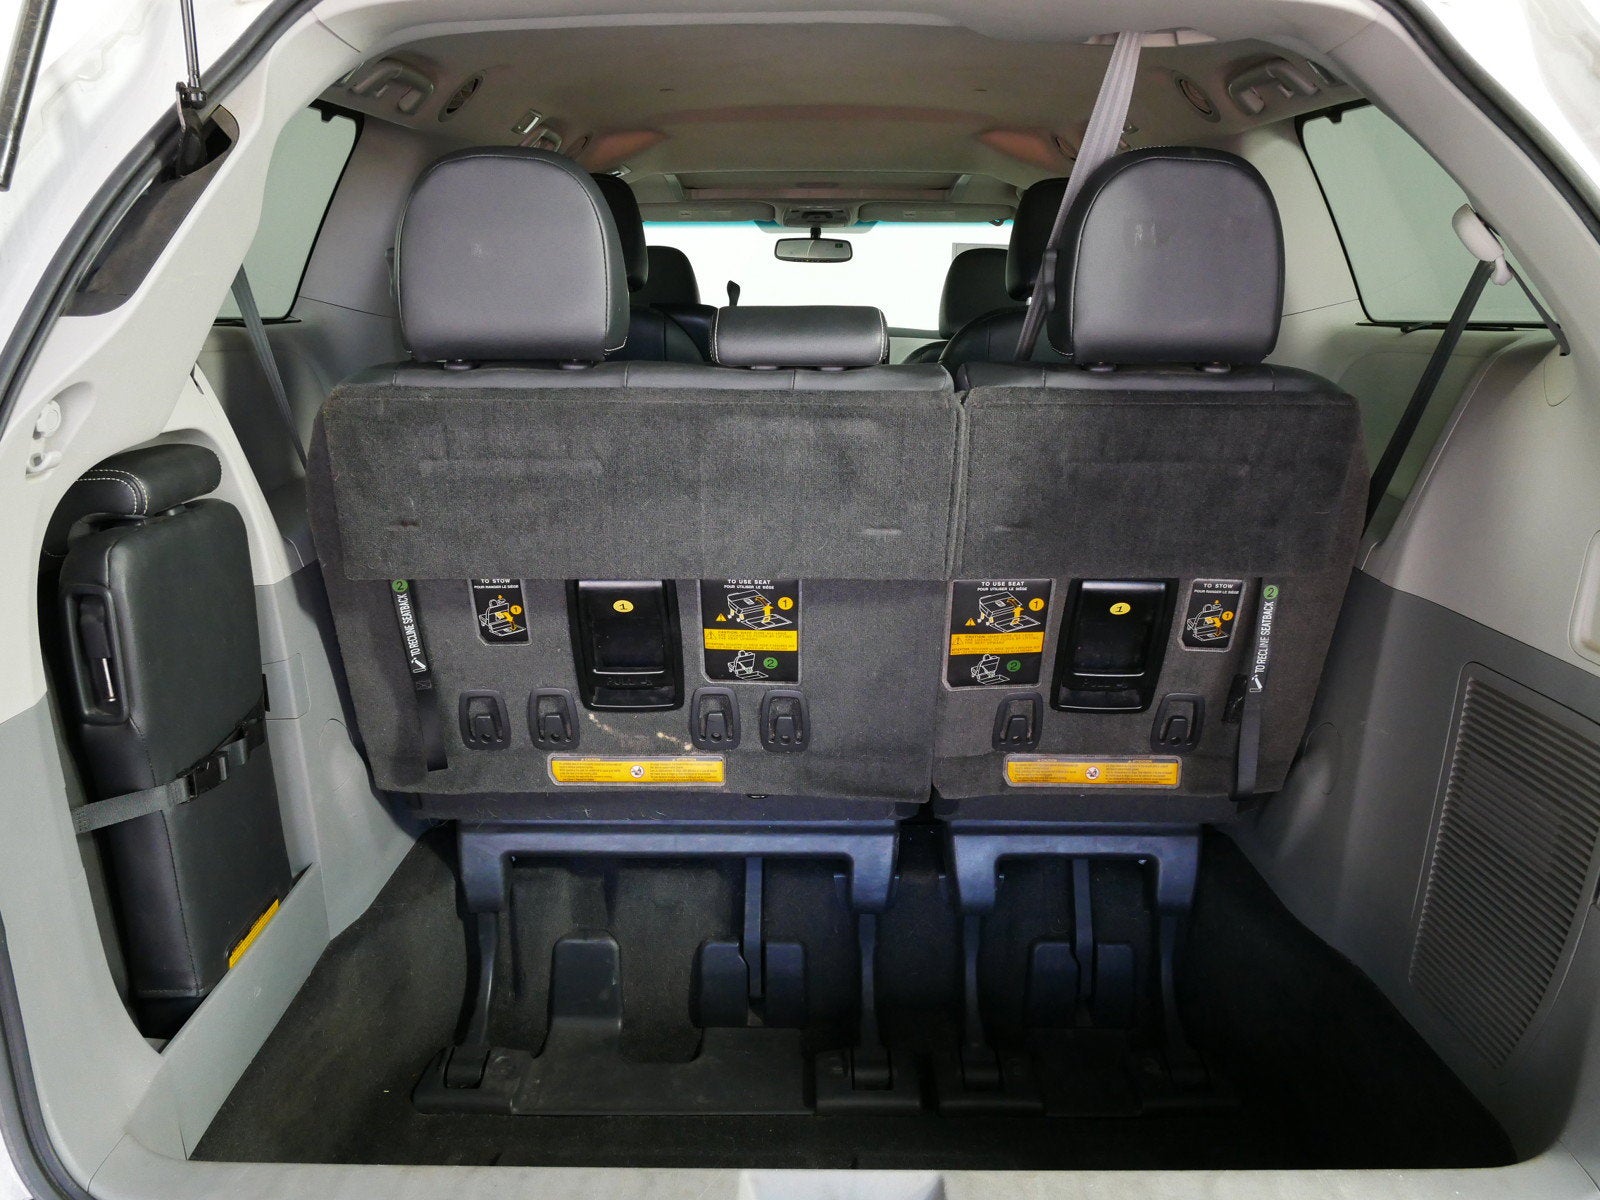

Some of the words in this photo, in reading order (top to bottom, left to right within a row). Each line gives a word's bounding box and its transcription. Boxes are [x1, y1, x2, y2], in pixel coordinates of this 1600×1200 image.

[396, 581, 403, 591] 2
[1267, 587, 1274, 598] 2
[397, 593, 413, 625] SEATBACK
[1261, 601, 1275, 636] SEATBACK
[404, 623, 420, 649] RECLINE
[410, 648, 421, 657] TO
[1256, 636, 1270, 665] RECLINE
[766, 658, 775, 668] 2
[1010, 661, 1018, 670] 2
[1254, 664, 1266, 674] TO
